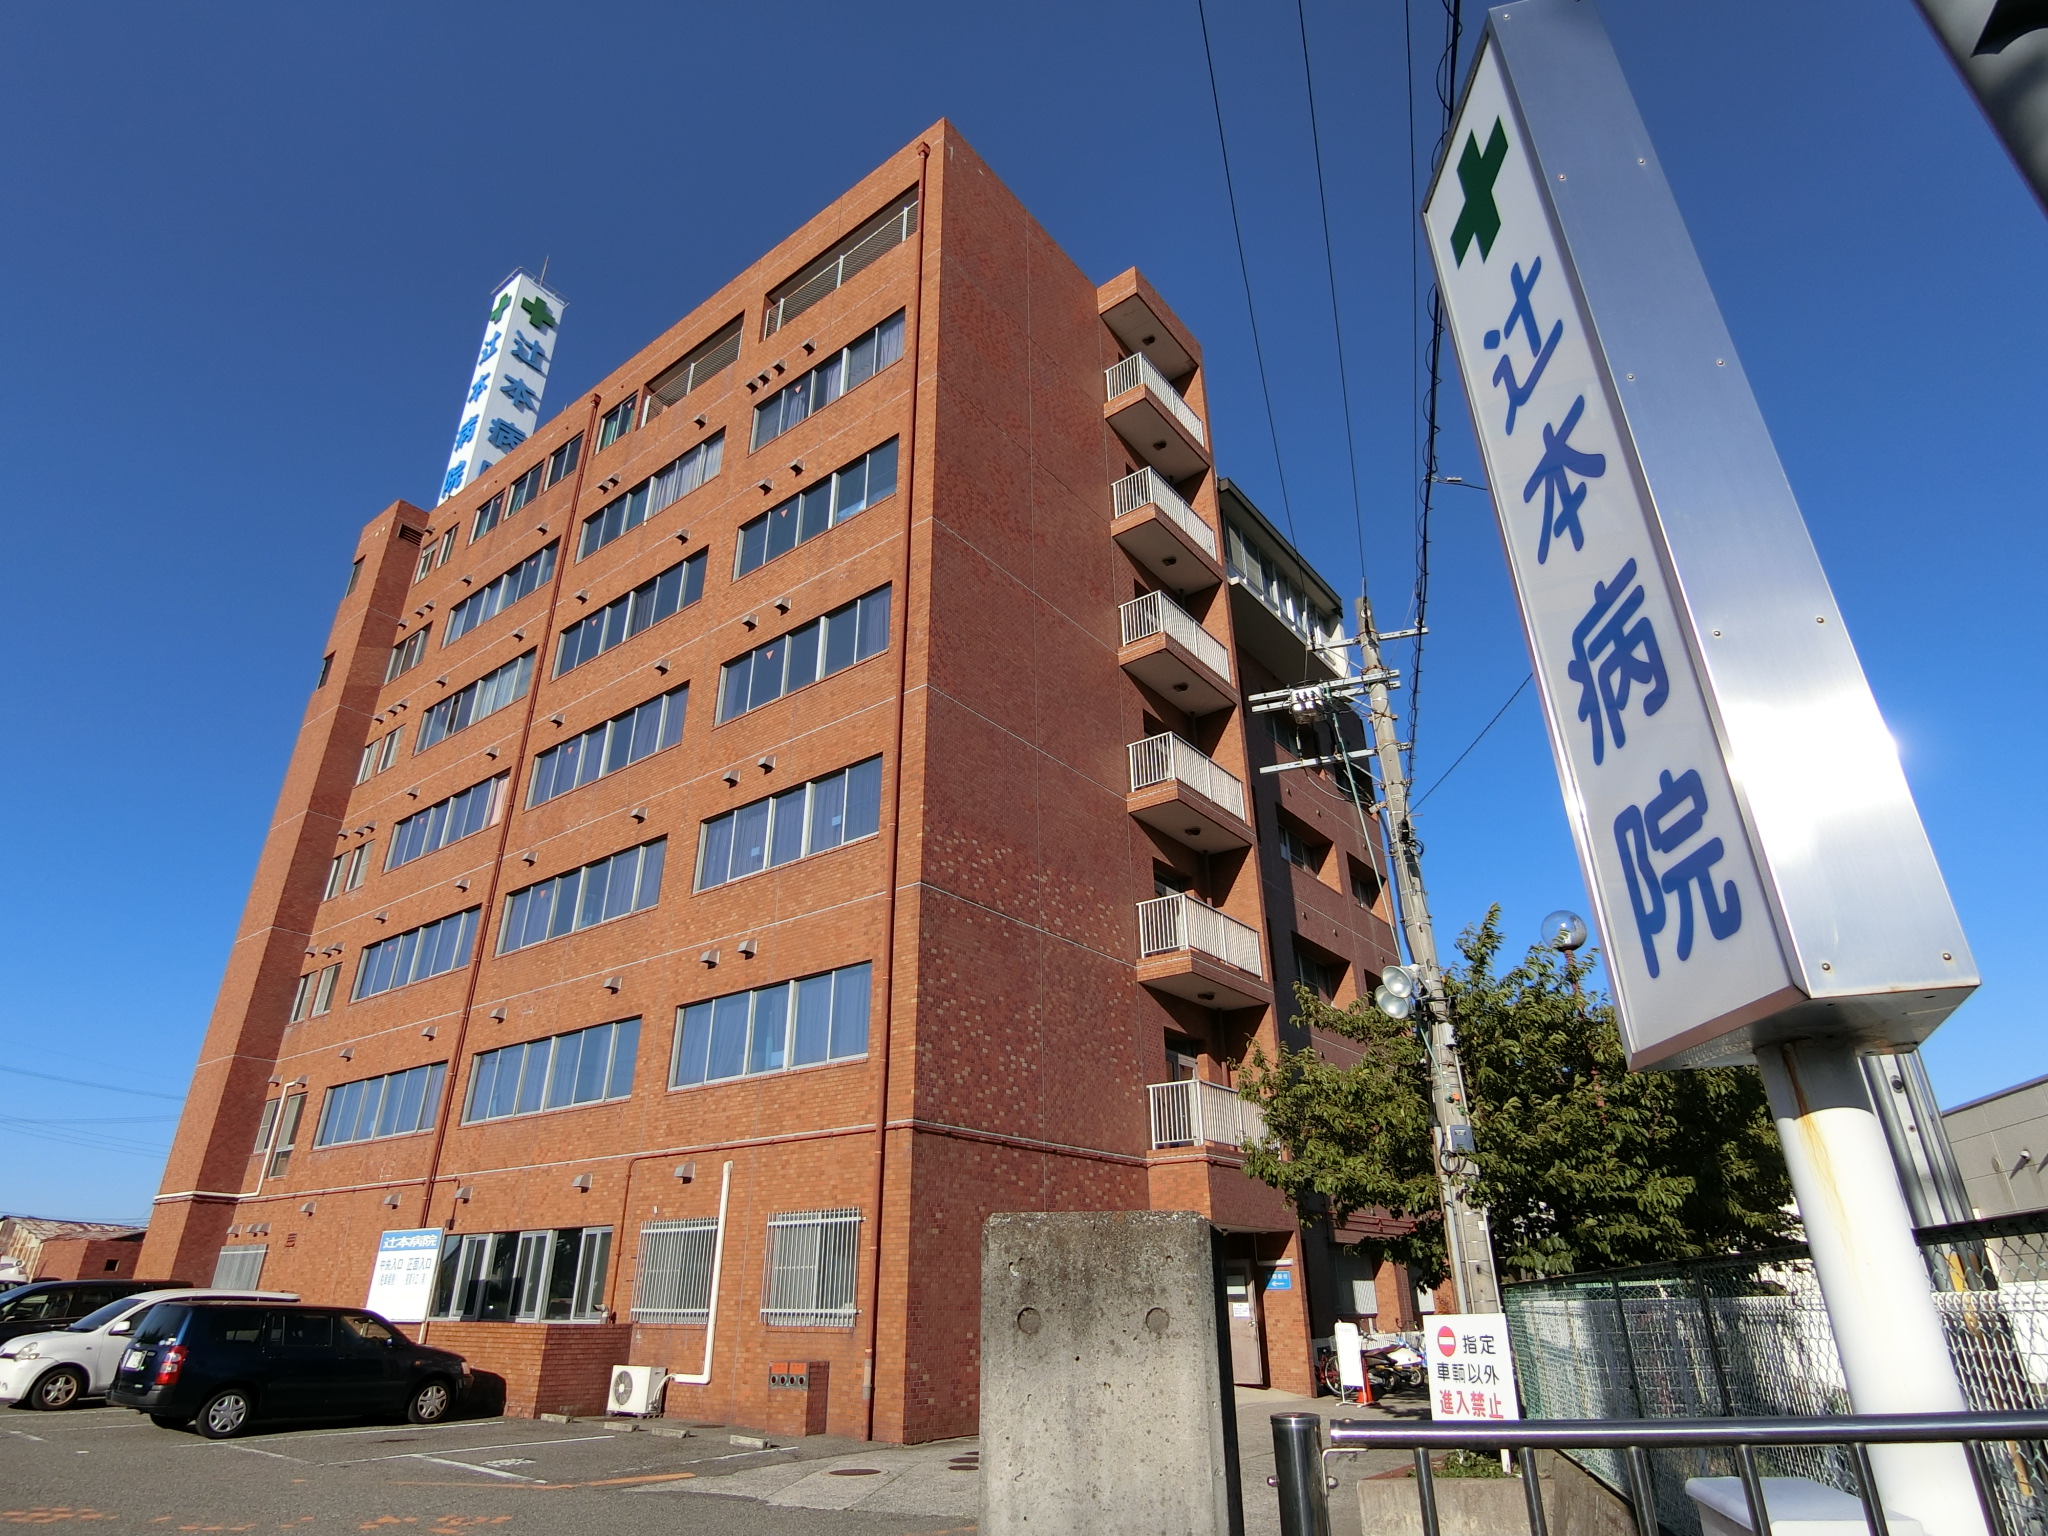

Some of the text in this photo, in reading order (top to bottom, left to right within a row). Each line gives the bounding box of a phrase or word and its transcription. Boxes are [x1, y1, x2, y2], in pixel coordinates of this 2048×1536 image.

[442, 331, 501, 498] 辻本病院
[479, 329, 546, 477] 辻本病
[1483, 256, 1741, 979] 辻本病院
[383, 1234, 437, 1249] 辻本病院
[1462, 1334, 1496, 1355] 指定
[1439, 1389, 1504, 1419] 進入禁止
